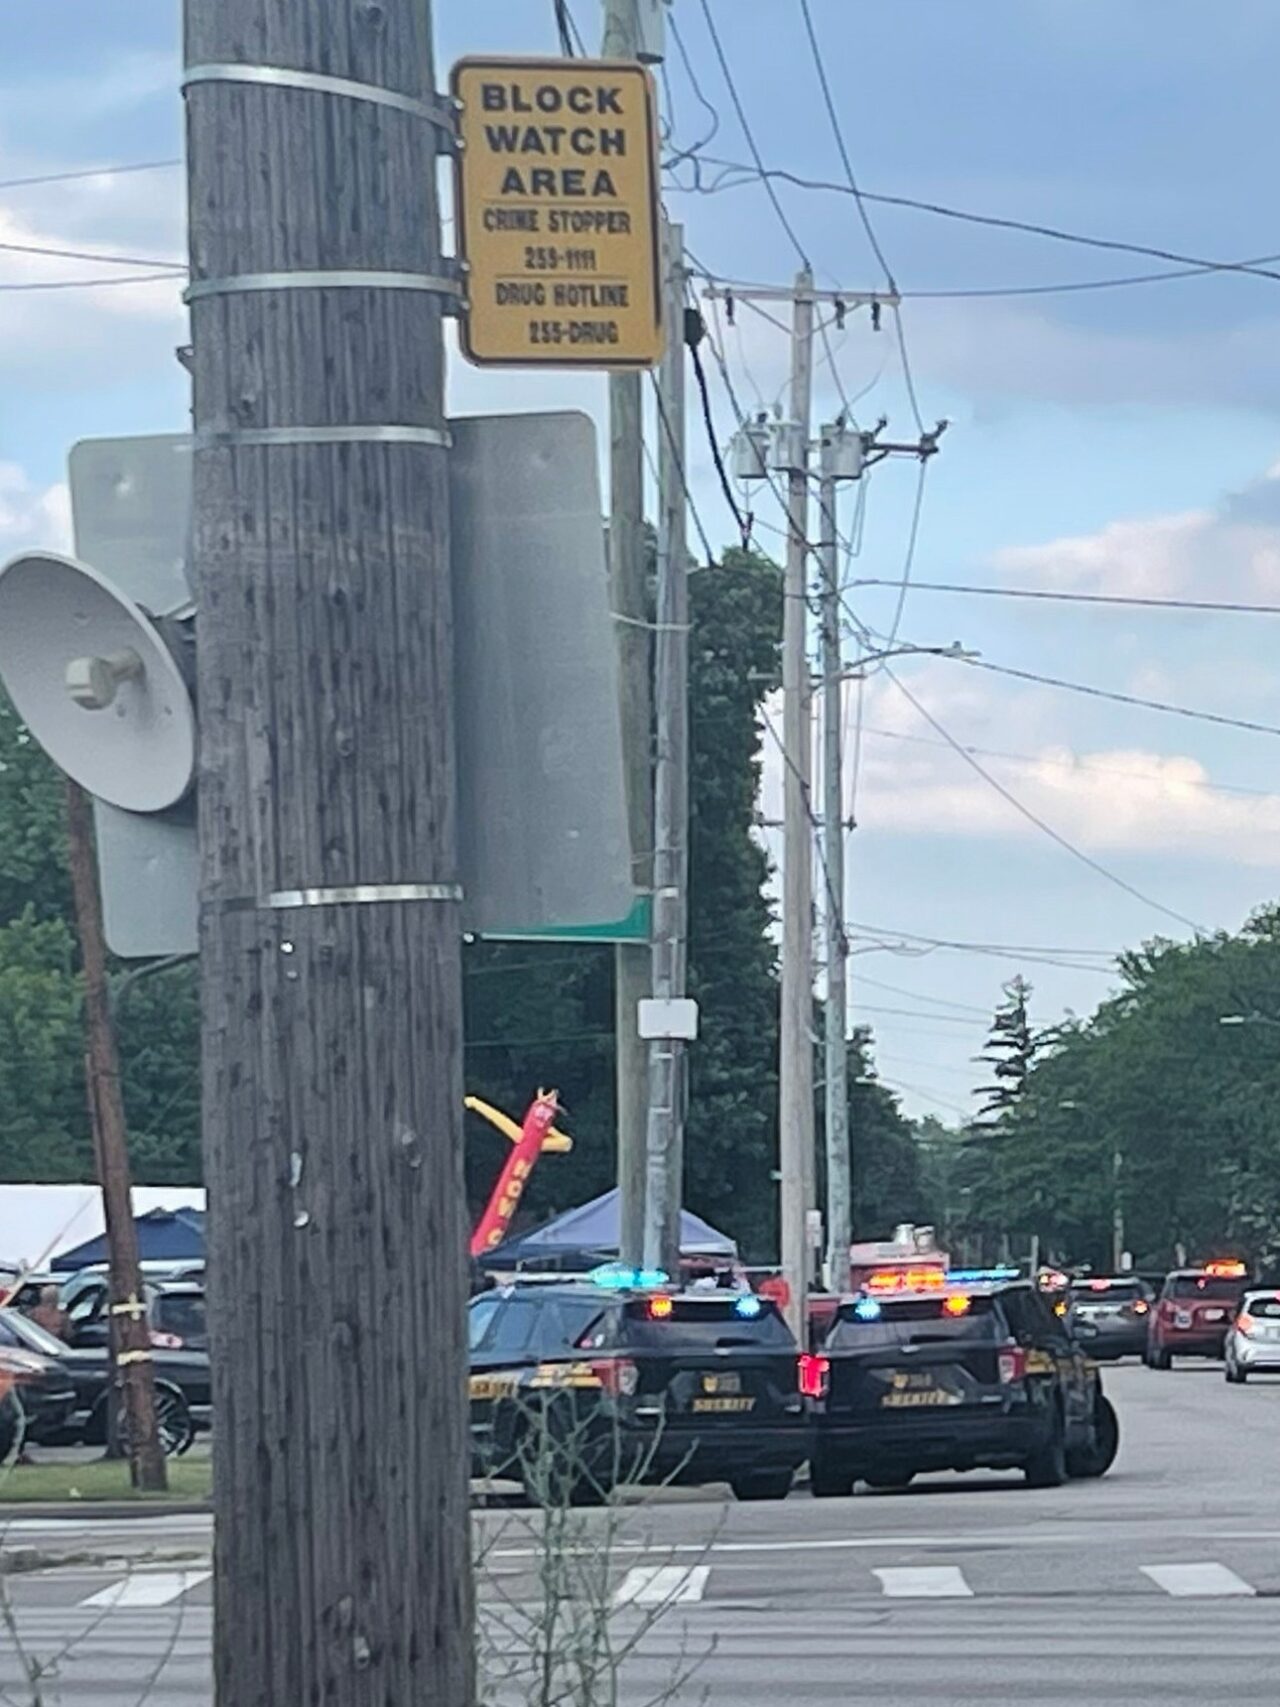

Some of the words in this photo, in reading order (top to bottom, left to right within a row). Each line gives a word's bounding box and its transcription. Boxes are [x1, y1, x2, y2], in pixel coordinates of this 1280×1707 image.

[481, 84, 624, 115] BLOCK
[484, 125, 627, 157] WATCH
[501, 167, 617, 197] AREA
[483, 208, 540, 233] CRIME
[548, 209, 631, 234] STOPPER
[495, 282, 546, 307] DRUG
[553, 283, 630, 308] HOTLINE
